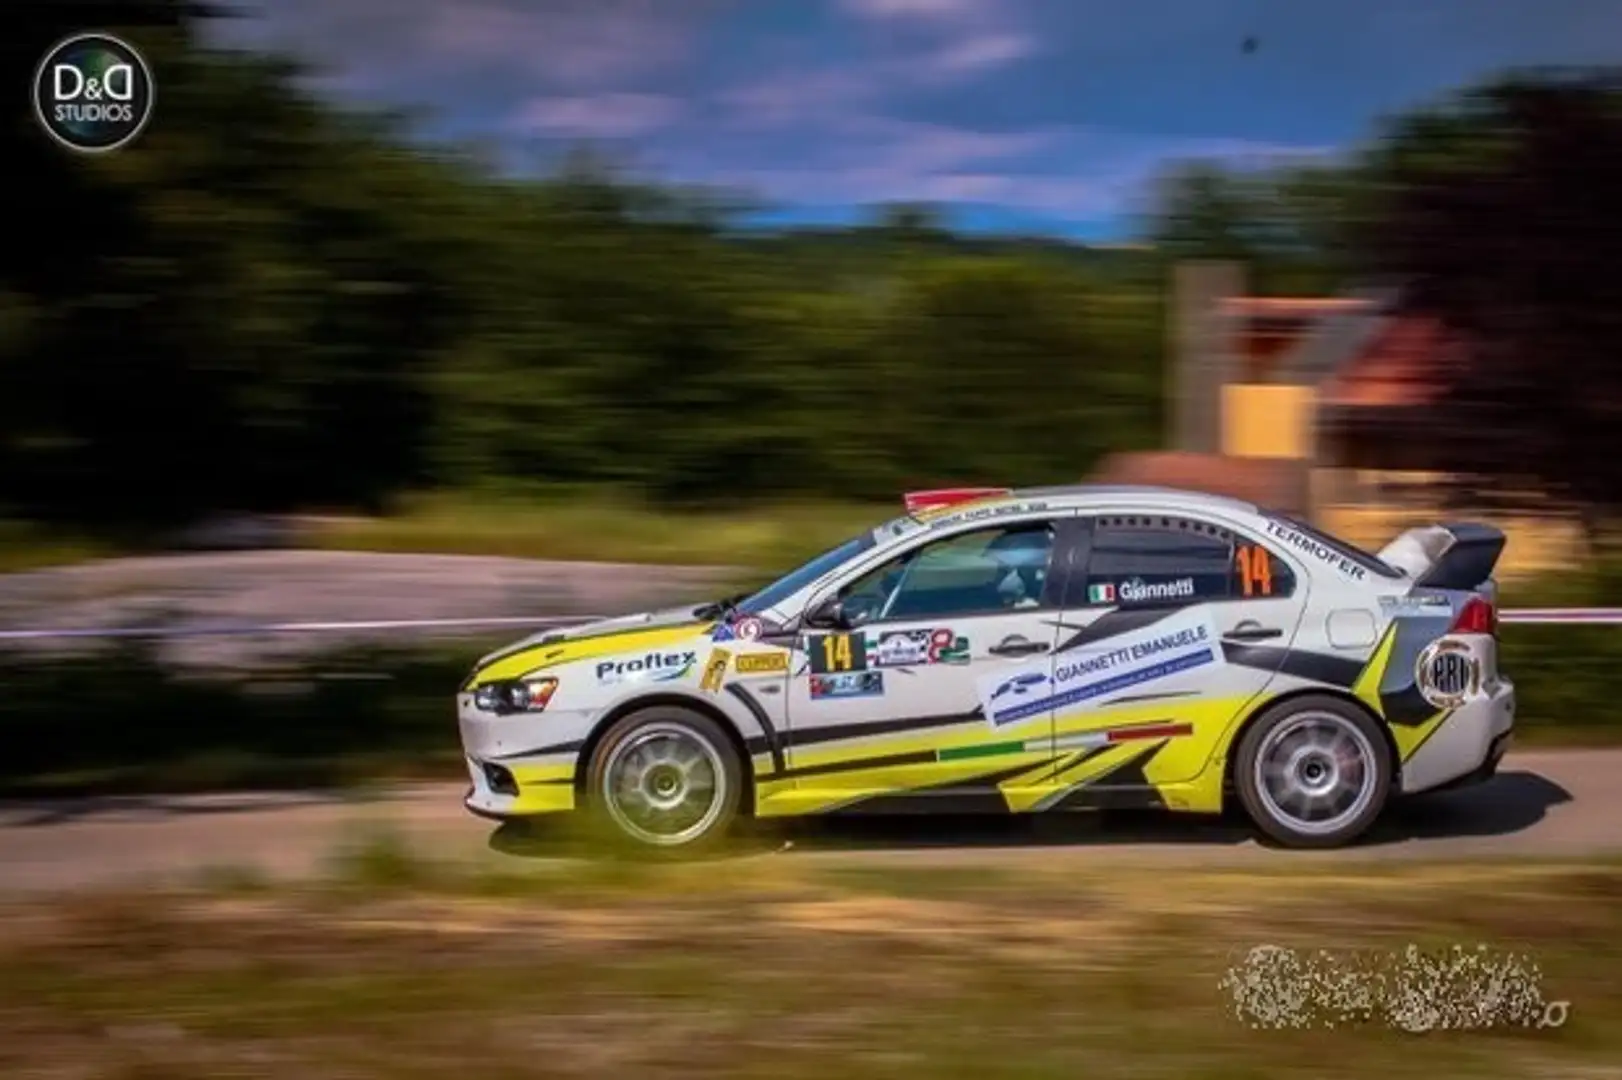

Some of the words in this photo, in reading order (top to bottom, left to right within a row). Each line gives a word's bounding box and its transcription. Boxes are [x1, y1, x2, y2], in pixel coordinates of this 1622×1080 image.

[1236, 544, 1271, 598] 14
[1266, 521, 1367, 581] TERMOFER
[1119, 577, 1194, 600] Giannetti
[595, 650, 697, 680] Proflex
[822, 633, 852, 672] 14
[1055, 652, 1131, 682] GIANNETTI
[1131, 624, 1208, 663] EMANUELE
